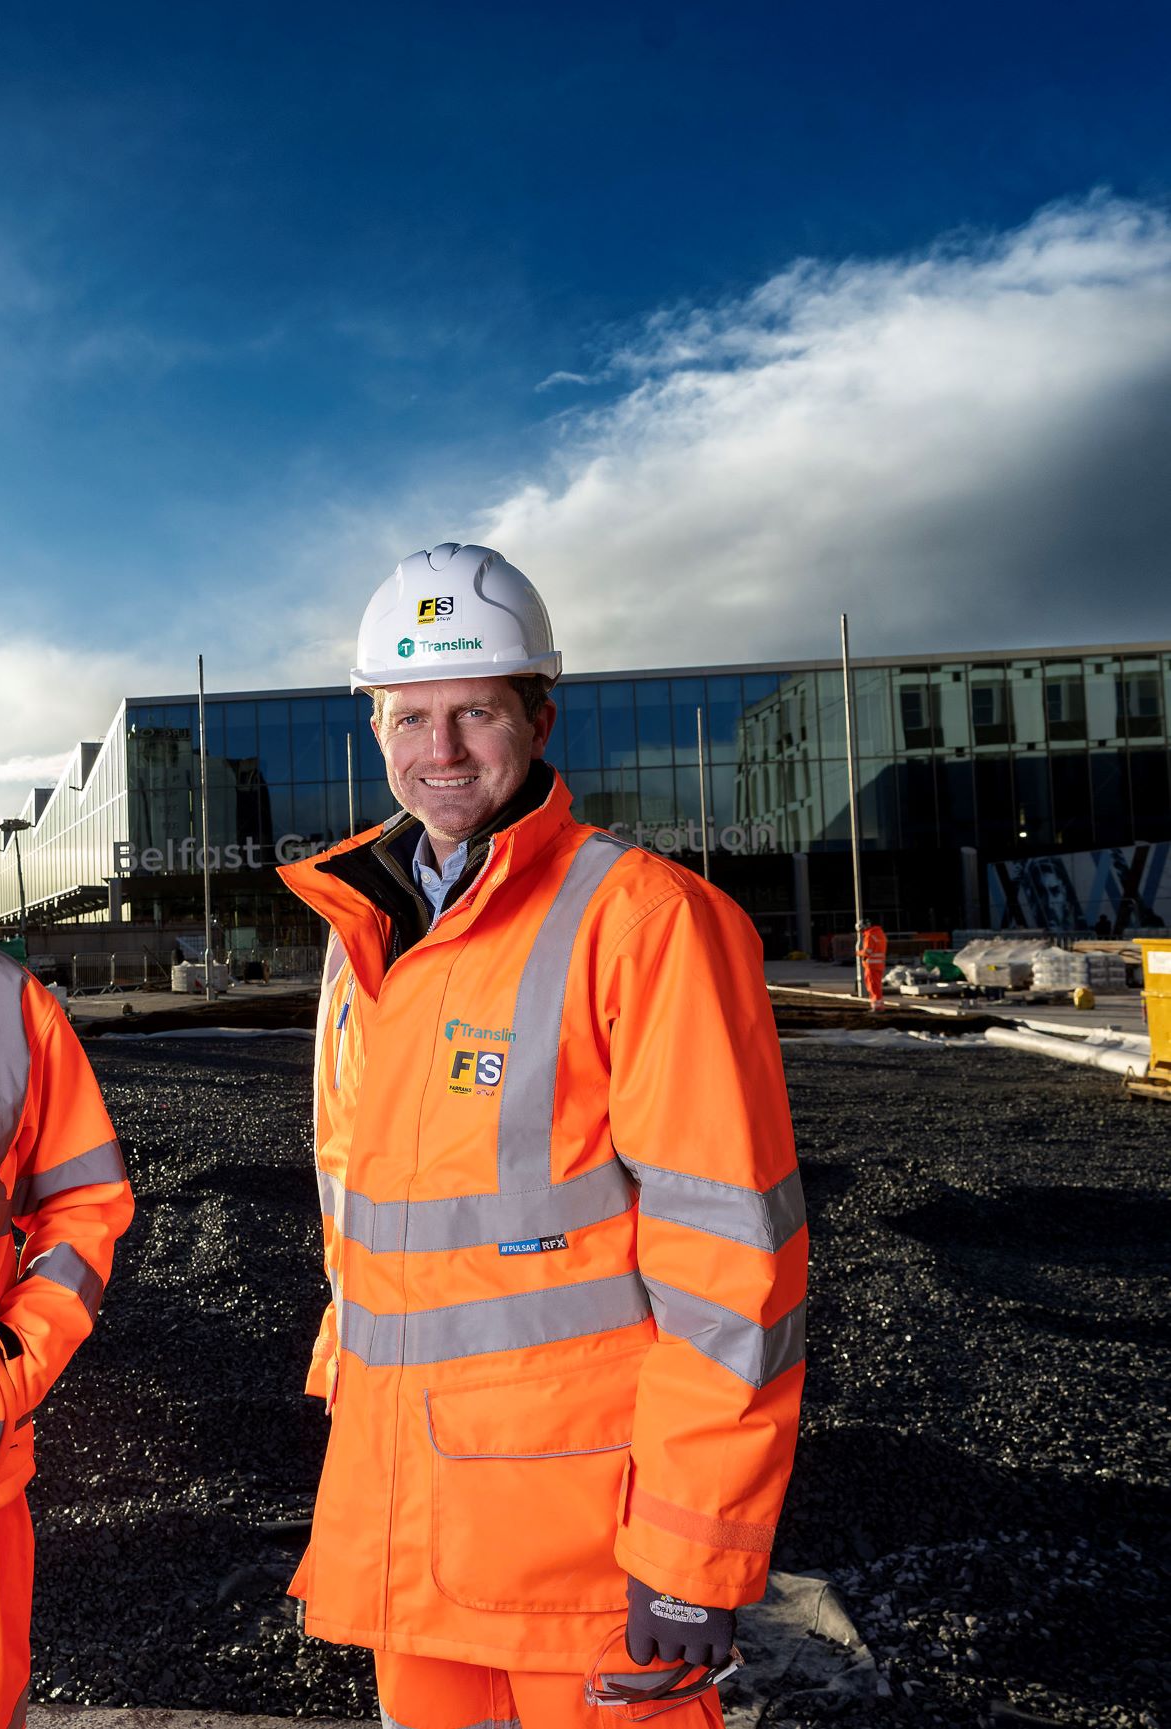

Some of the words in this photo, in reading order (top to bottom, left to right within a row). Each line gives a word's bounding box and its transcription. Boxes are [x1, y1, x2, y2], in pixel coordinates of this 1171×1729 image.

[419, 637, 483, 652] Translink
[113, 836, 263, 872] Belfast
[460, 1023, 517, 1042] Translin
[541, 1238, 566, 1250] RFX
